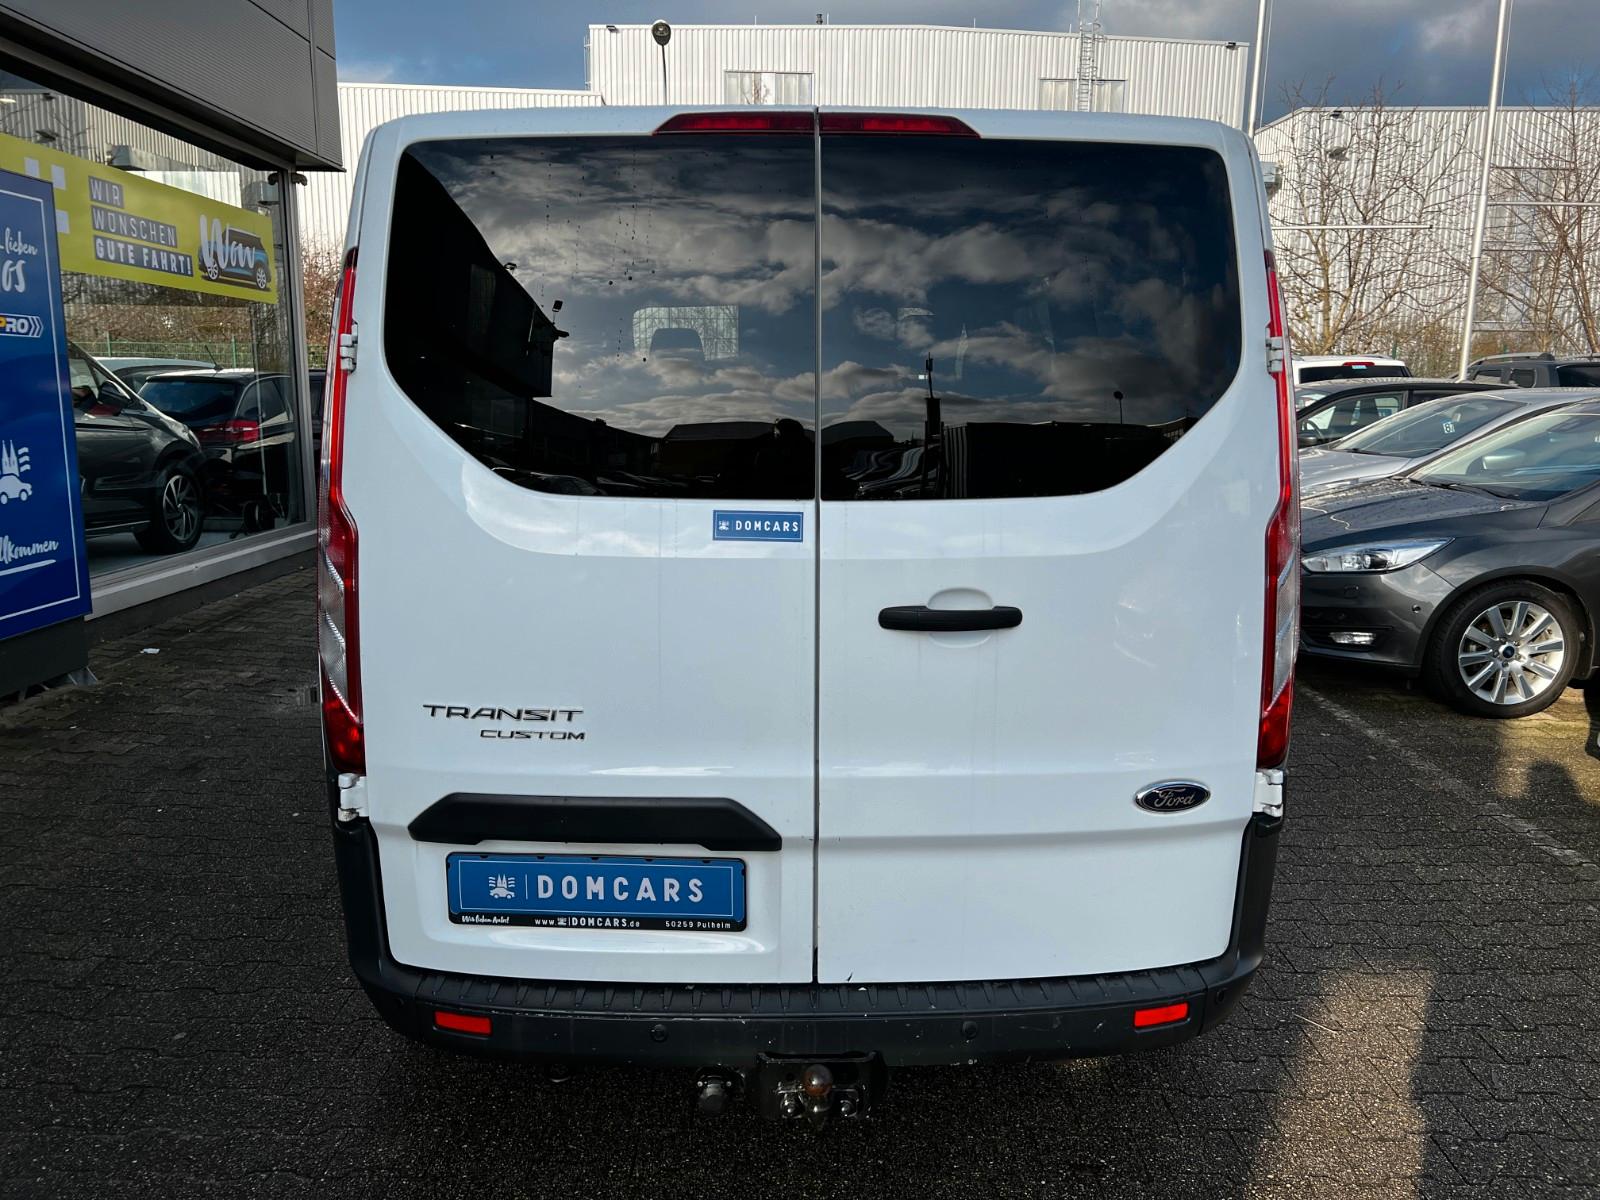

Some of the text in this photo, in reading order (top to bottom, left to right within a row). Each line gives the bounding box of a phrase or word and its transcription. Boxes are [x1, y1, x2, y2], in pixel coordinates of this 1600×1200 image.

[90, 178, 121, 206] WIR
[5, 226, 38, 256] lieben
[199, 214, 256, 270] Wow
[95, 238, 192, 275] GUTE FAHRT!
[735, 520, 799, 532] DOMCARS
[423, 704, 584, 722] TRANSIT
[480, 729, 585, 740] CUSTOM
[1152, 787, 1197, 807] Ford
[537, 874, 704, 903] DOMCARS
[665, 920, 731, 929] 50259 Pulheim
